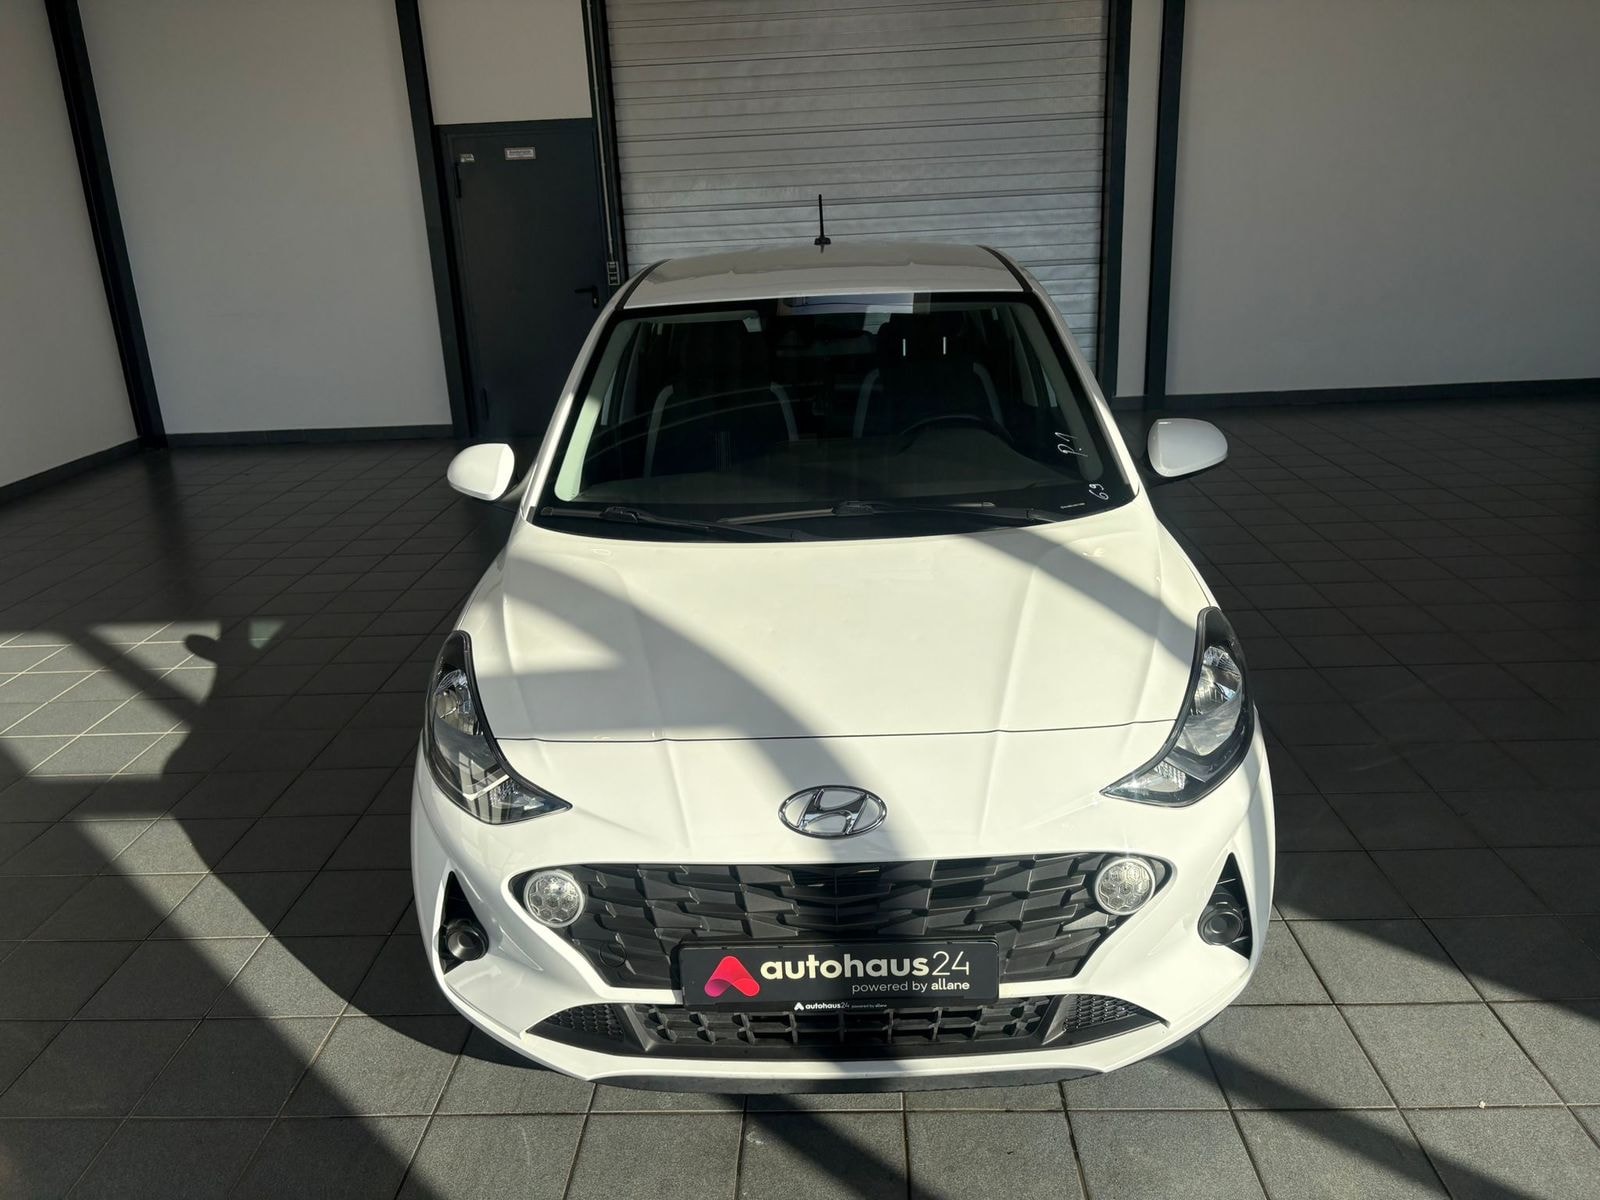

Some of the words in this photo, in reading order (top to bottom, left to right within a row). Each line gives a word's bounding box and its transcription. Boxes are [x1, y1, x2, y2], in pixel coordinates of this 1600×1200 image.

[760, 951, 970, 980] autohaus24
[852, 981, 908, 994] powered
[912, 980, 928, 992] by
[931, 979, 970, 991] allane
[805, 1001, 850, 1010] autohaus24
